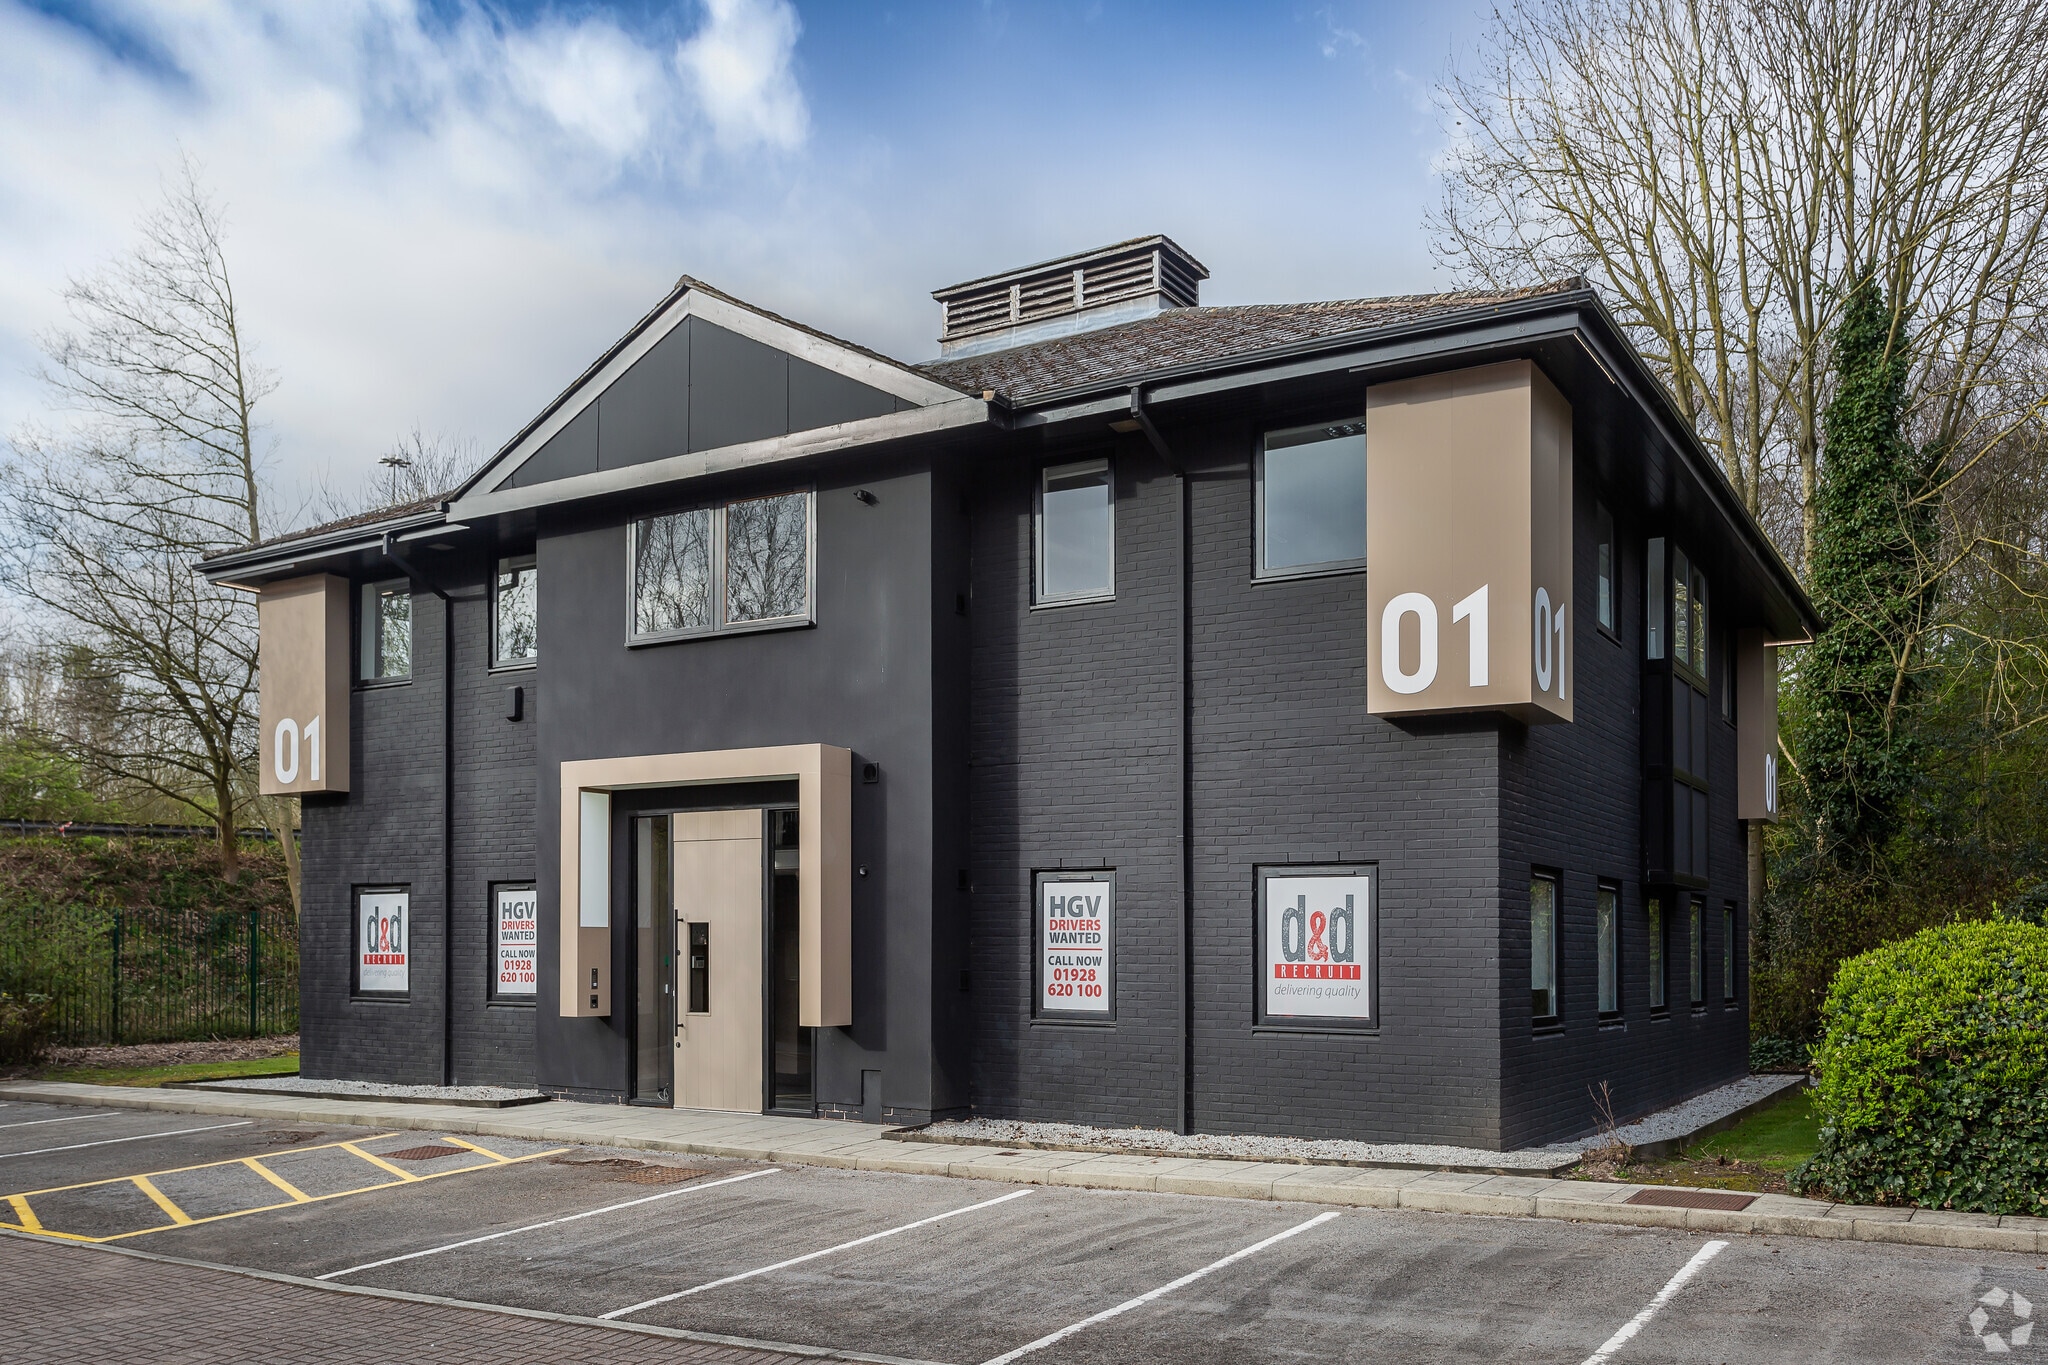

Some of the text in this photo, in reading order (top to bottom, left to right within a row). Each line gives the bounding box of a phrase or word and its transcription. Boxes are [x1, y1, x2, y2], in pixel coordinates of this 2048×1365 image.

[1381, 583, 1489, 694] 01
[1534, 586, 1565, 701] 01
[274, 714, 320, 784] 01
[1765, 753, 1776, 814] 01
[502, 901, 535, 920] HGV
[1049, 895, 1102, 918] HGV
[367, 905, 402, 954] d&d
[501, 920, 535, 931] DRIVERS
[1049, 919, 1101, 931] DRIVERS
[1281, 894, 1354, 963] d&d
[501, 931, 535, 941] WANTED
[1049, 932, 1102, 944] WANTED
[500, 949, 536, 959] CALL NOW
[1048, 955, 1102, 967] CALL NOW
[504, 960, 532, 971] 01928
[1280, 964, 1355, 979] RECRUIT
[500, 972, 536, 983] 620 100
[1053, 968, 1096, 982] 01928
[1047, 983, 1102, 998] 620 100
[1274, 984, 1361, 1000] delivering quality
